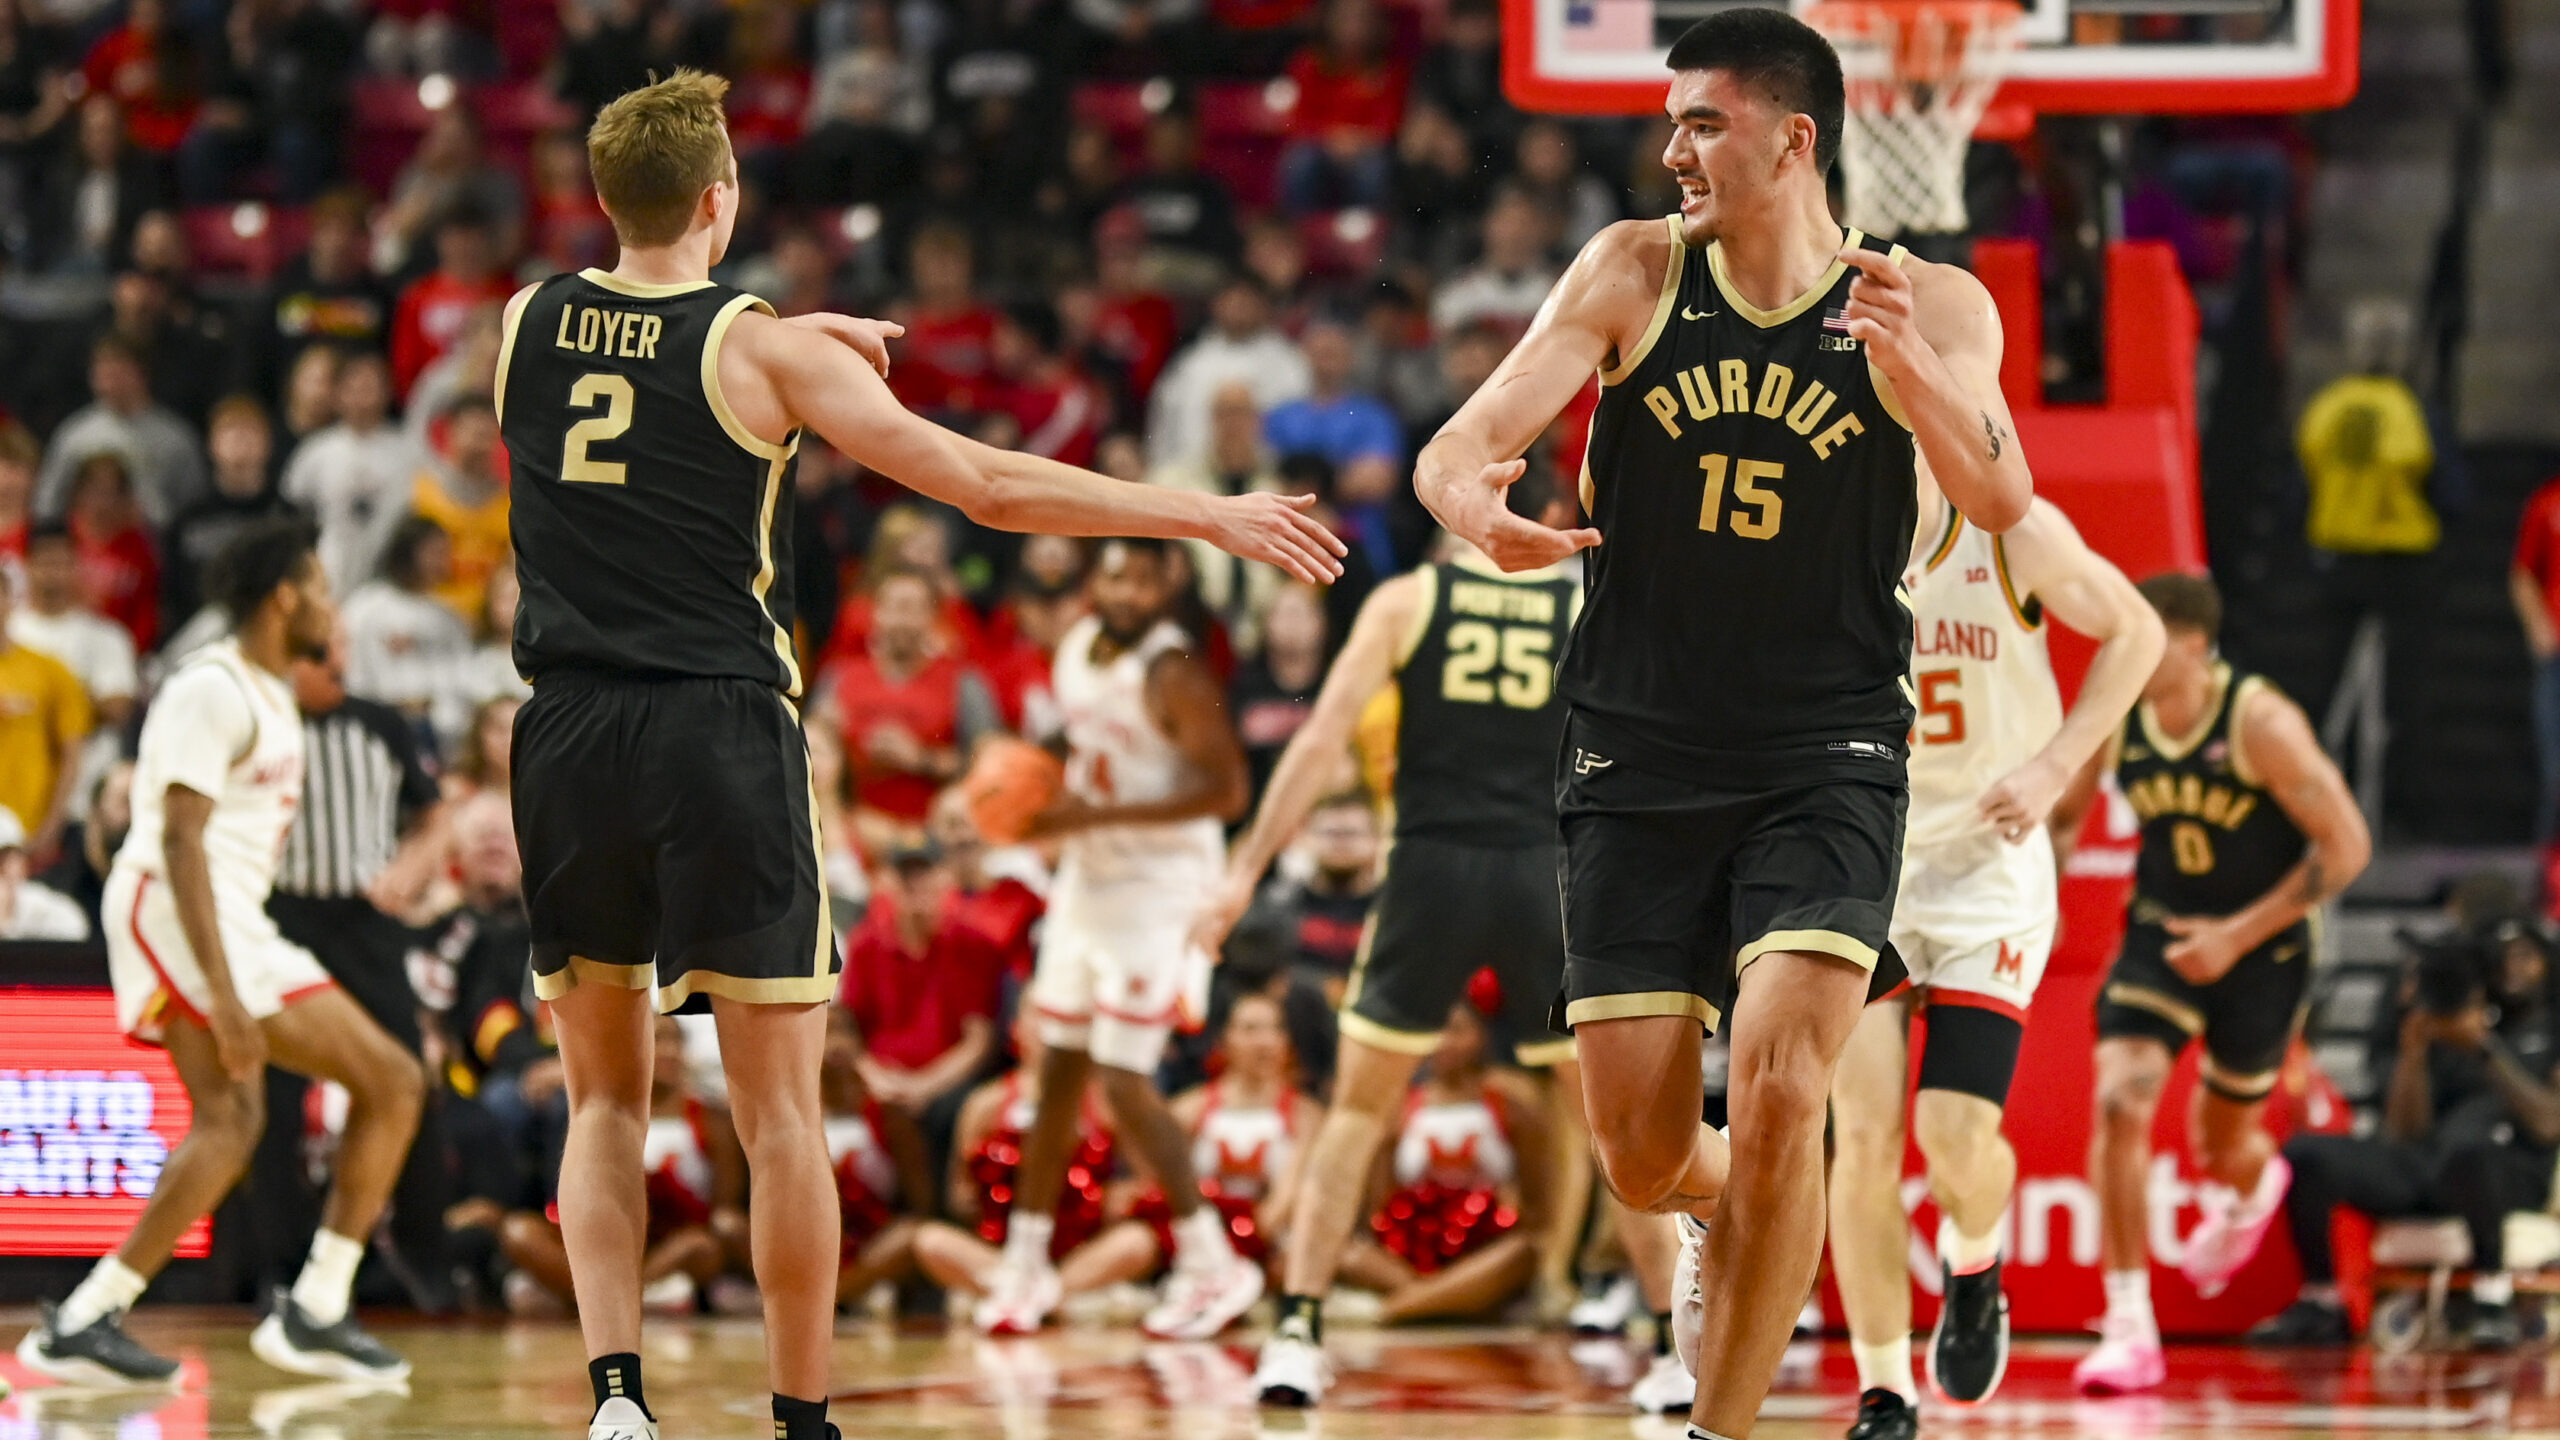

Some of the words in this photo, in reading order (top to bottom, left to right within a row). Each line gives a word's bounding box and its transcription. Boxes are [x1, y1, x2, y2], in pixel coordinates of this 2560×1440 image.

[555, 303, 663, 360] LOYER
[560, 372, 635, 485] 2
[1643, 358, 1866, 461] PURDUE
[1698, 452, 1785, 541] 15
[1442, 620, 1553, 711] 25
[1914, 618, 1998, 662] LAND
[1908, 668, 1966, 745] 5
[0, 1130, 168, 1198] ARTS
